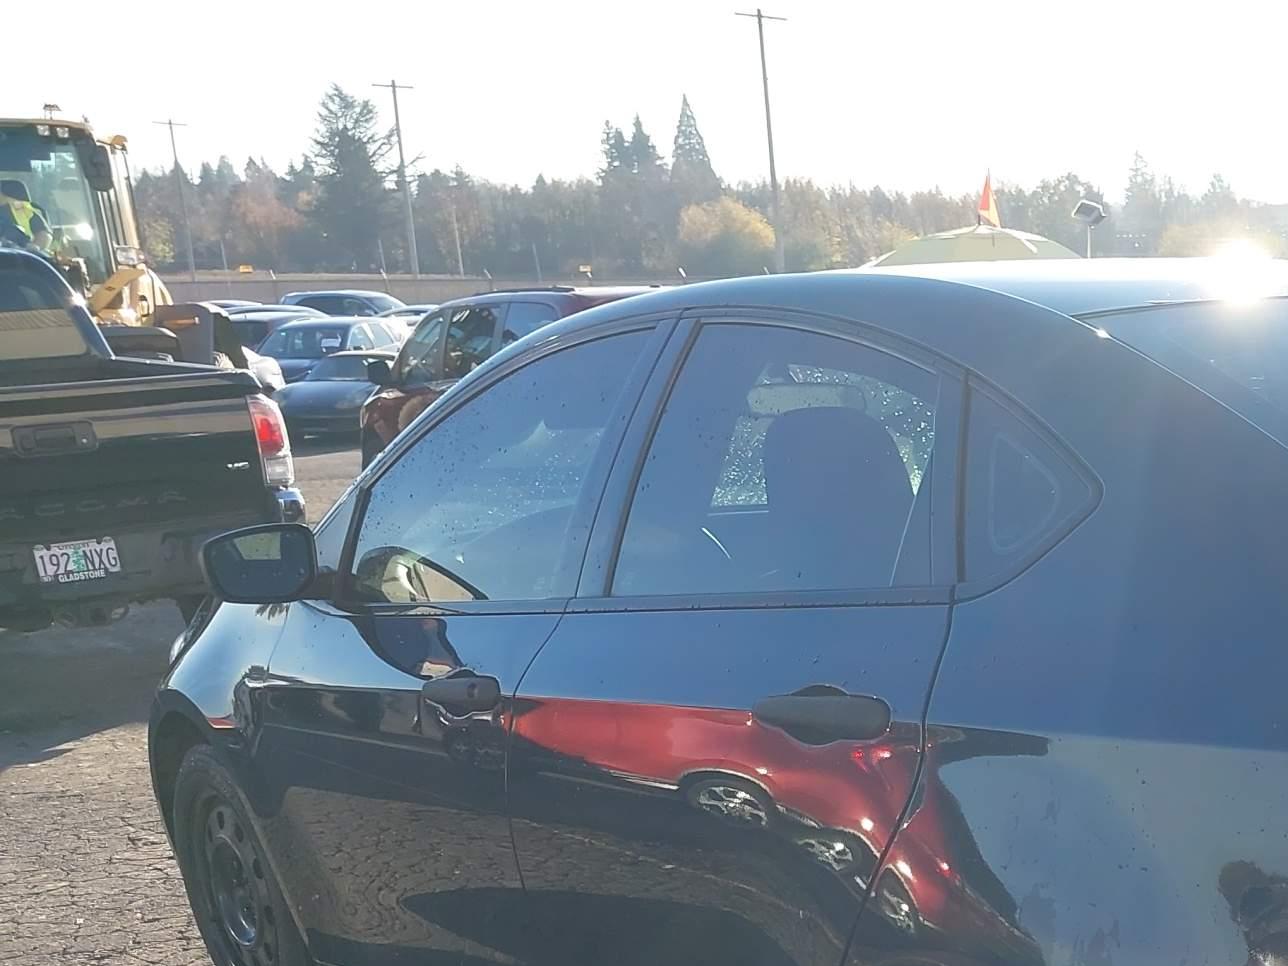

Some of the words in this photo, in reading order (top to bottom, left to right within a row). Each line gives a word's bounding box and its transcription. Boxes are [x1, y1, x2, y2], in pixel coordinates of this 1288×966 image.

[38, 552, 71, 576] 192
[82, 547, 118, 571] NXG
[58, 569, 106, 583] GLADSTONE
